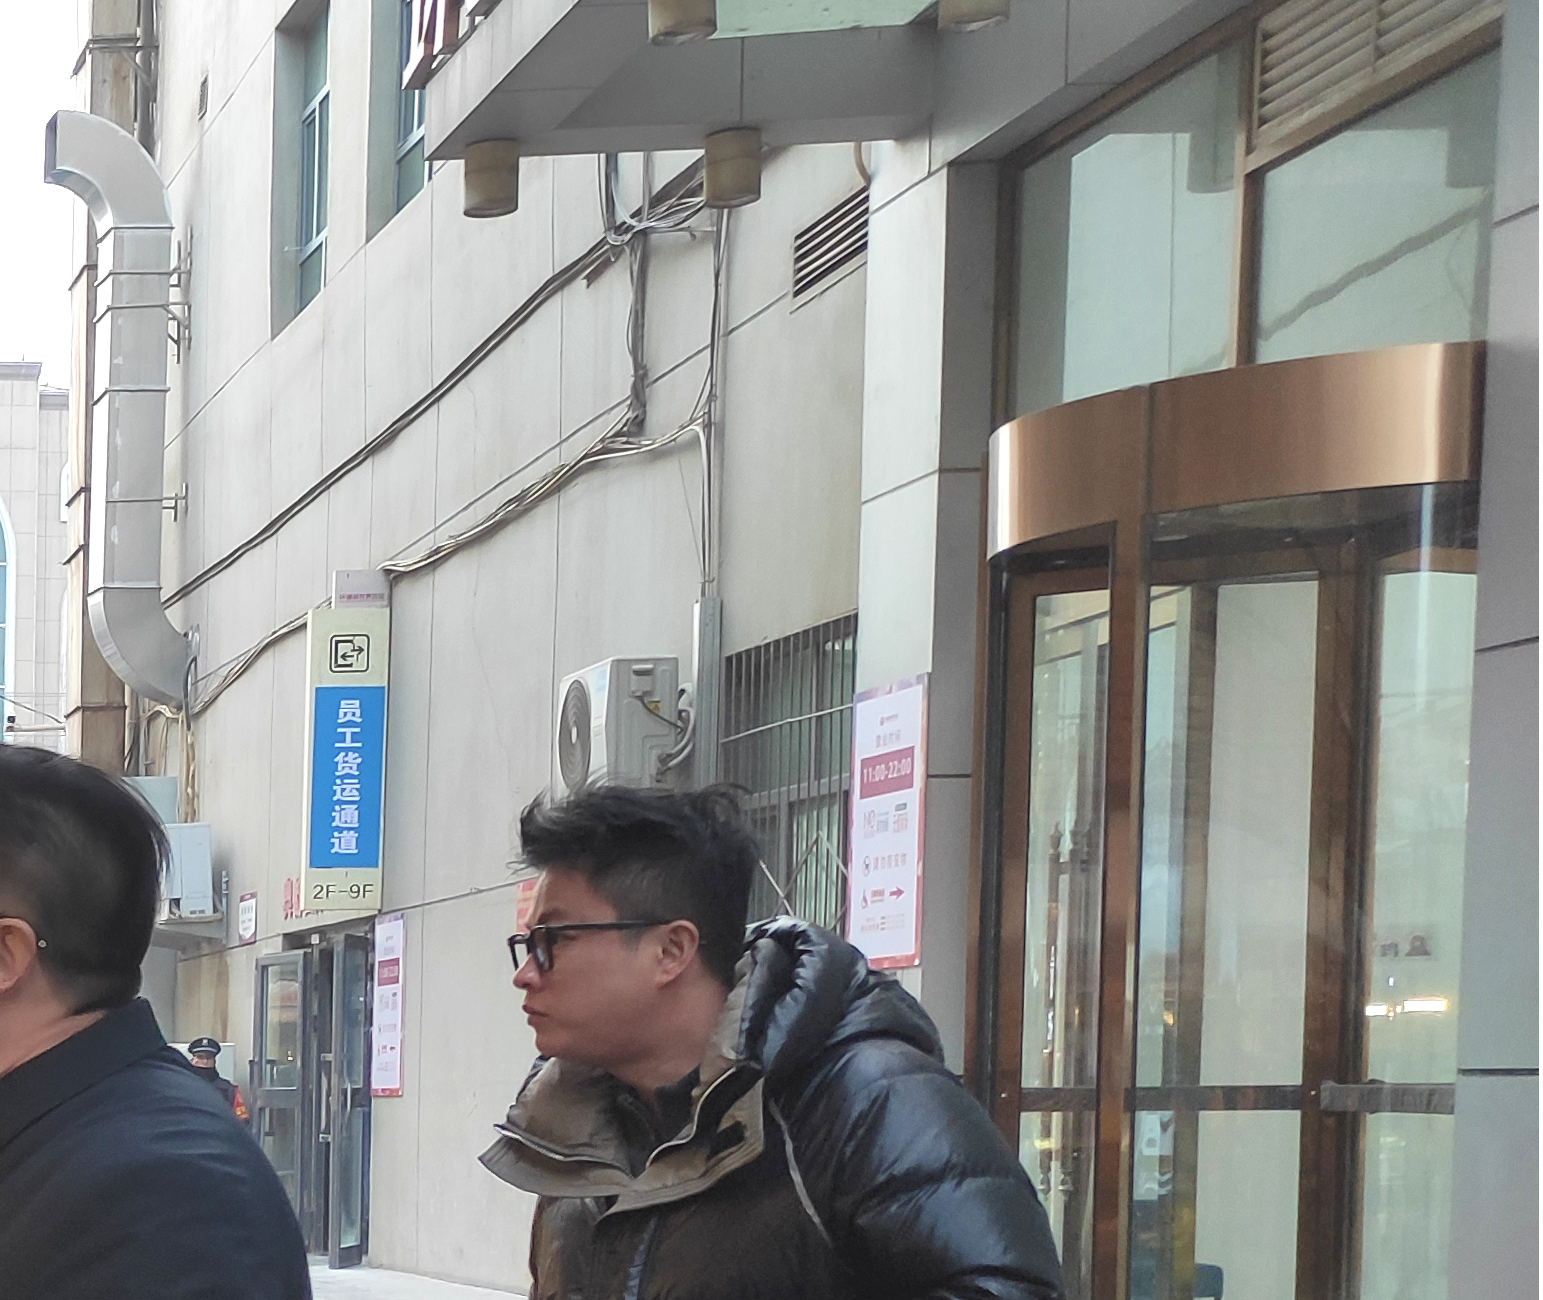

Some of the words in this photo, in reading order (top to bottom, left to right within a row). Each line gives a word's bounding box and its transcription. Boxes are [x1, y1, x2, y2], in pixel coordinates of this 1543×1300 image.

[330, 700, 363, 854] 员工货运通道
[863, 757, 912, 784] 11:00-22:00
[313, 883, 375, 901] 2F-9F
